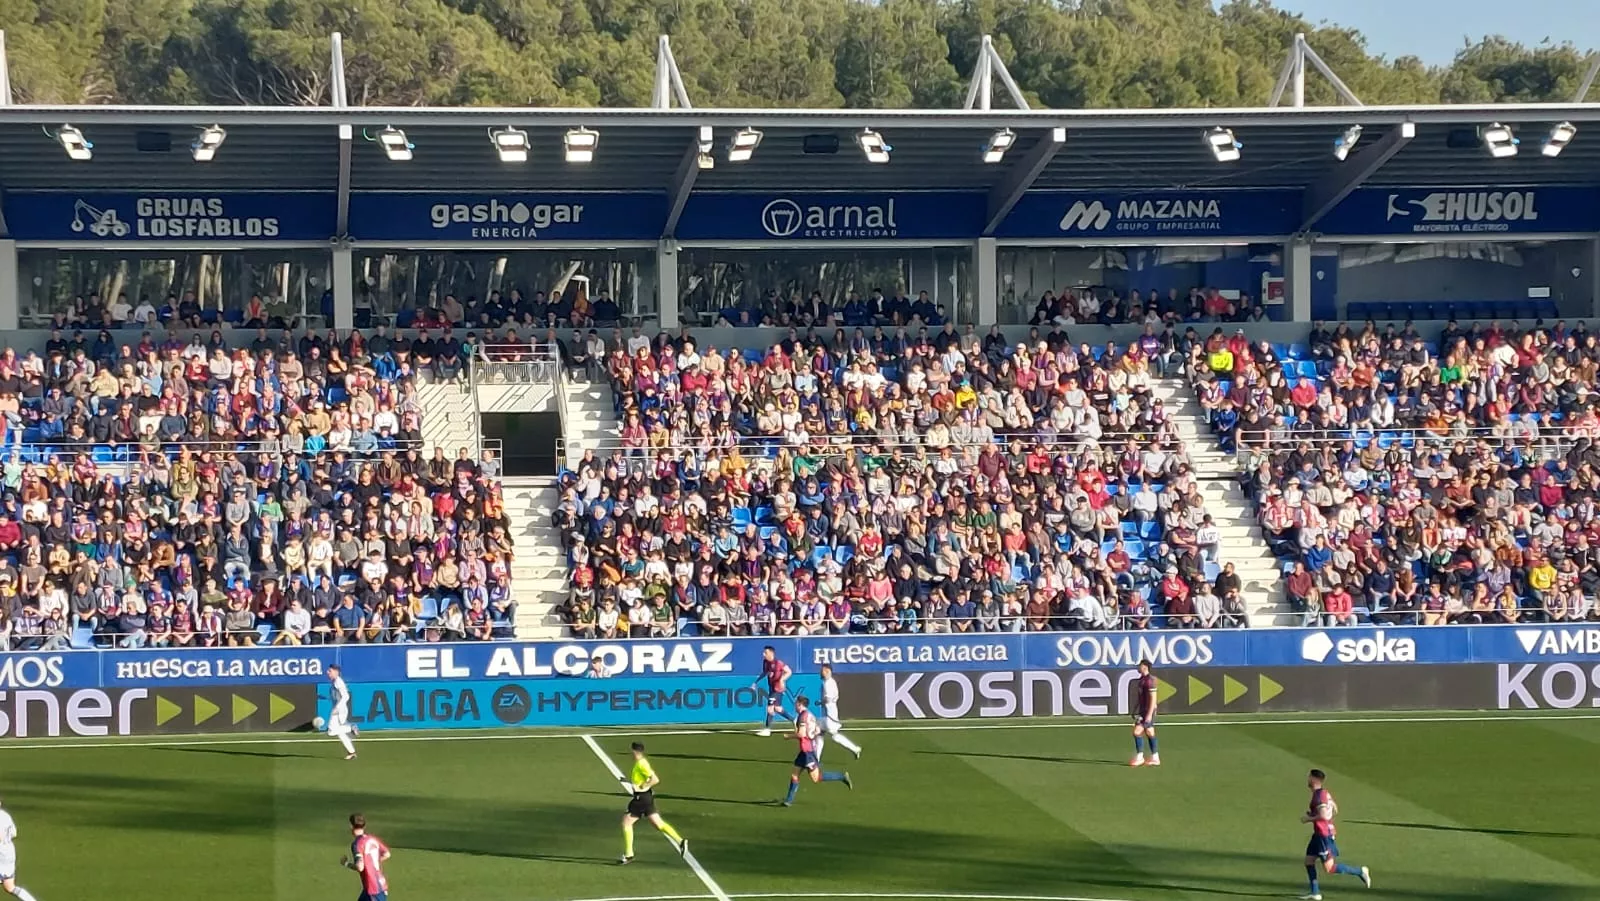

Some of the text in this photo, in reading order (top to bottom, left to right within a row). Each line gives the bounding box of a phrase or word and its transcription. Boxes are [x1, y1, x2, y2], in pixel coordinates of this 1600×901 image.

[136, 198, 223, 217] GRUAS
[806, 198, 896, 228] arnal
[1117, 200, 1221, 219] MAZANA
[1421, 191, 1538, 221] EHUSOL
[136, 218, 279, 237] LOSFABLOS
[471, 226, 537, 238] ENERGÍA
[804, 229, 897, 237] ELECTRICIDAD
[1116, 221, 1221, 231] GRUPO EMPRESARIAL
[1413, 224, 1460, 232] MAYORISTA
[1056, 635, 1213, 667] SOMMOS
[1336, 630, 1415, 662] soka
[1539, 629, 1600, 655] AMB
[407, 643, 733, 678] EL ALCORAZ
[1498, 662, 1600, 709] KO
